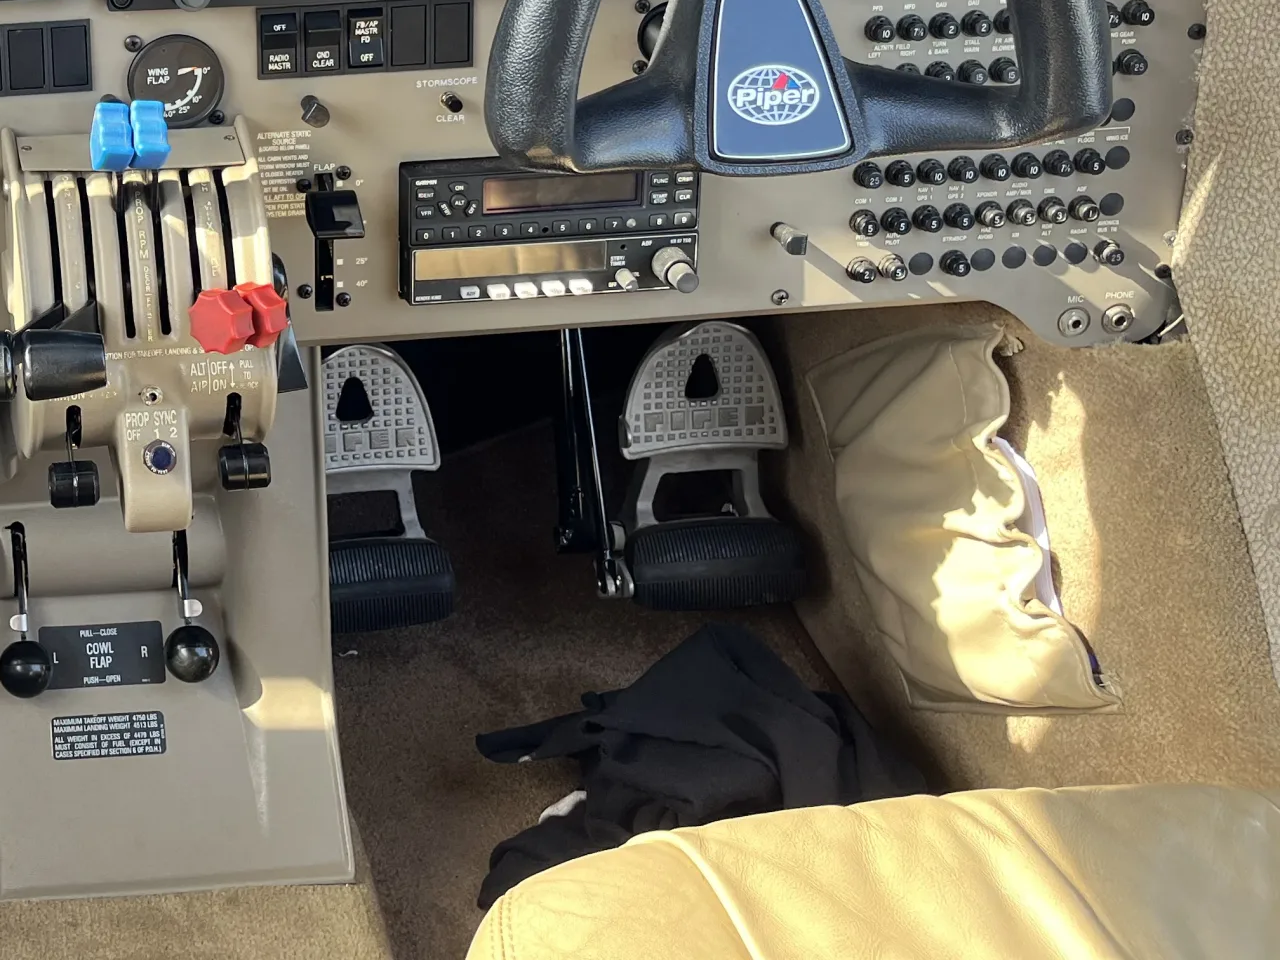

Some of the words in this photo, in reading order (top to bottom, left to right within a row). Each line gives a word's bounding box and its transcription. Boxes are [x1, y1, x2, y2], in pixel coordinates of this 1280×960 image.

[1141, 12, 1150, 21] 10
[356, 20, 379, 29] FD/AP
[355, 27, 378, 35] MASTR
[882, 29, 891, 39] 10
[360, 35, 370, 43] FD
[269, 53, 290, 62] RADIO
[316, 51, 330, 59] GND
[360, 53, 374, 62] OFF
[268, 61, 291, 70] MASTR
[312, 59, 334, 68] CLEAR
[147, 67, 169, 77] WING
[146, 76, 170, 85] FLAP
[415, 76, 478, 88] STORMSCOPE
[736, 87, 815, 111] Piper
[436, 114, 465, 123] CLEAR
[257, 131, 290, 140] ALTERNATE
[291, 130, 312, 138] STATIC
[271, 138, 297, 146] SOURCE
[313, 163, 336, 171] FLAP
[934, 172, 943, 181] 10
[966, 171, 974, 179] 10
[1068, 295, 1085, 304] MIC
[1105, 291, 1135, 300] PHONE
[211, 360, 228, 375] OFF
[239, 359, 254, 368] PULL
[190, 362, 206, 377] ALT
[243, 371, 252, 380] TO
[213, 379, 227, 391] ON
[125, 411, 150, 428] PROP
[153, 409, 177, 426] SYNC
[86, 641, 115, 655] COWL
[140, 645, 149, 658] R
[53, 651, 59, 664] L
[89, 655, 113, 669] FLAP
[53, 718, 82, 726] MAXIMUM
[83, 716, 107, 724] TAKEOFF
[107, 714, 130, 723] WEIGHT
[132, 713, 146, 722] 4750
[146, 713, 158, 721] LBS
[53, 725, 83, 734] MAXIMUM
[83, 723, 109, 732] LANDING
[109, 722, 131, 730] WEIGHT
[133, 721, 147, 729] 4513
